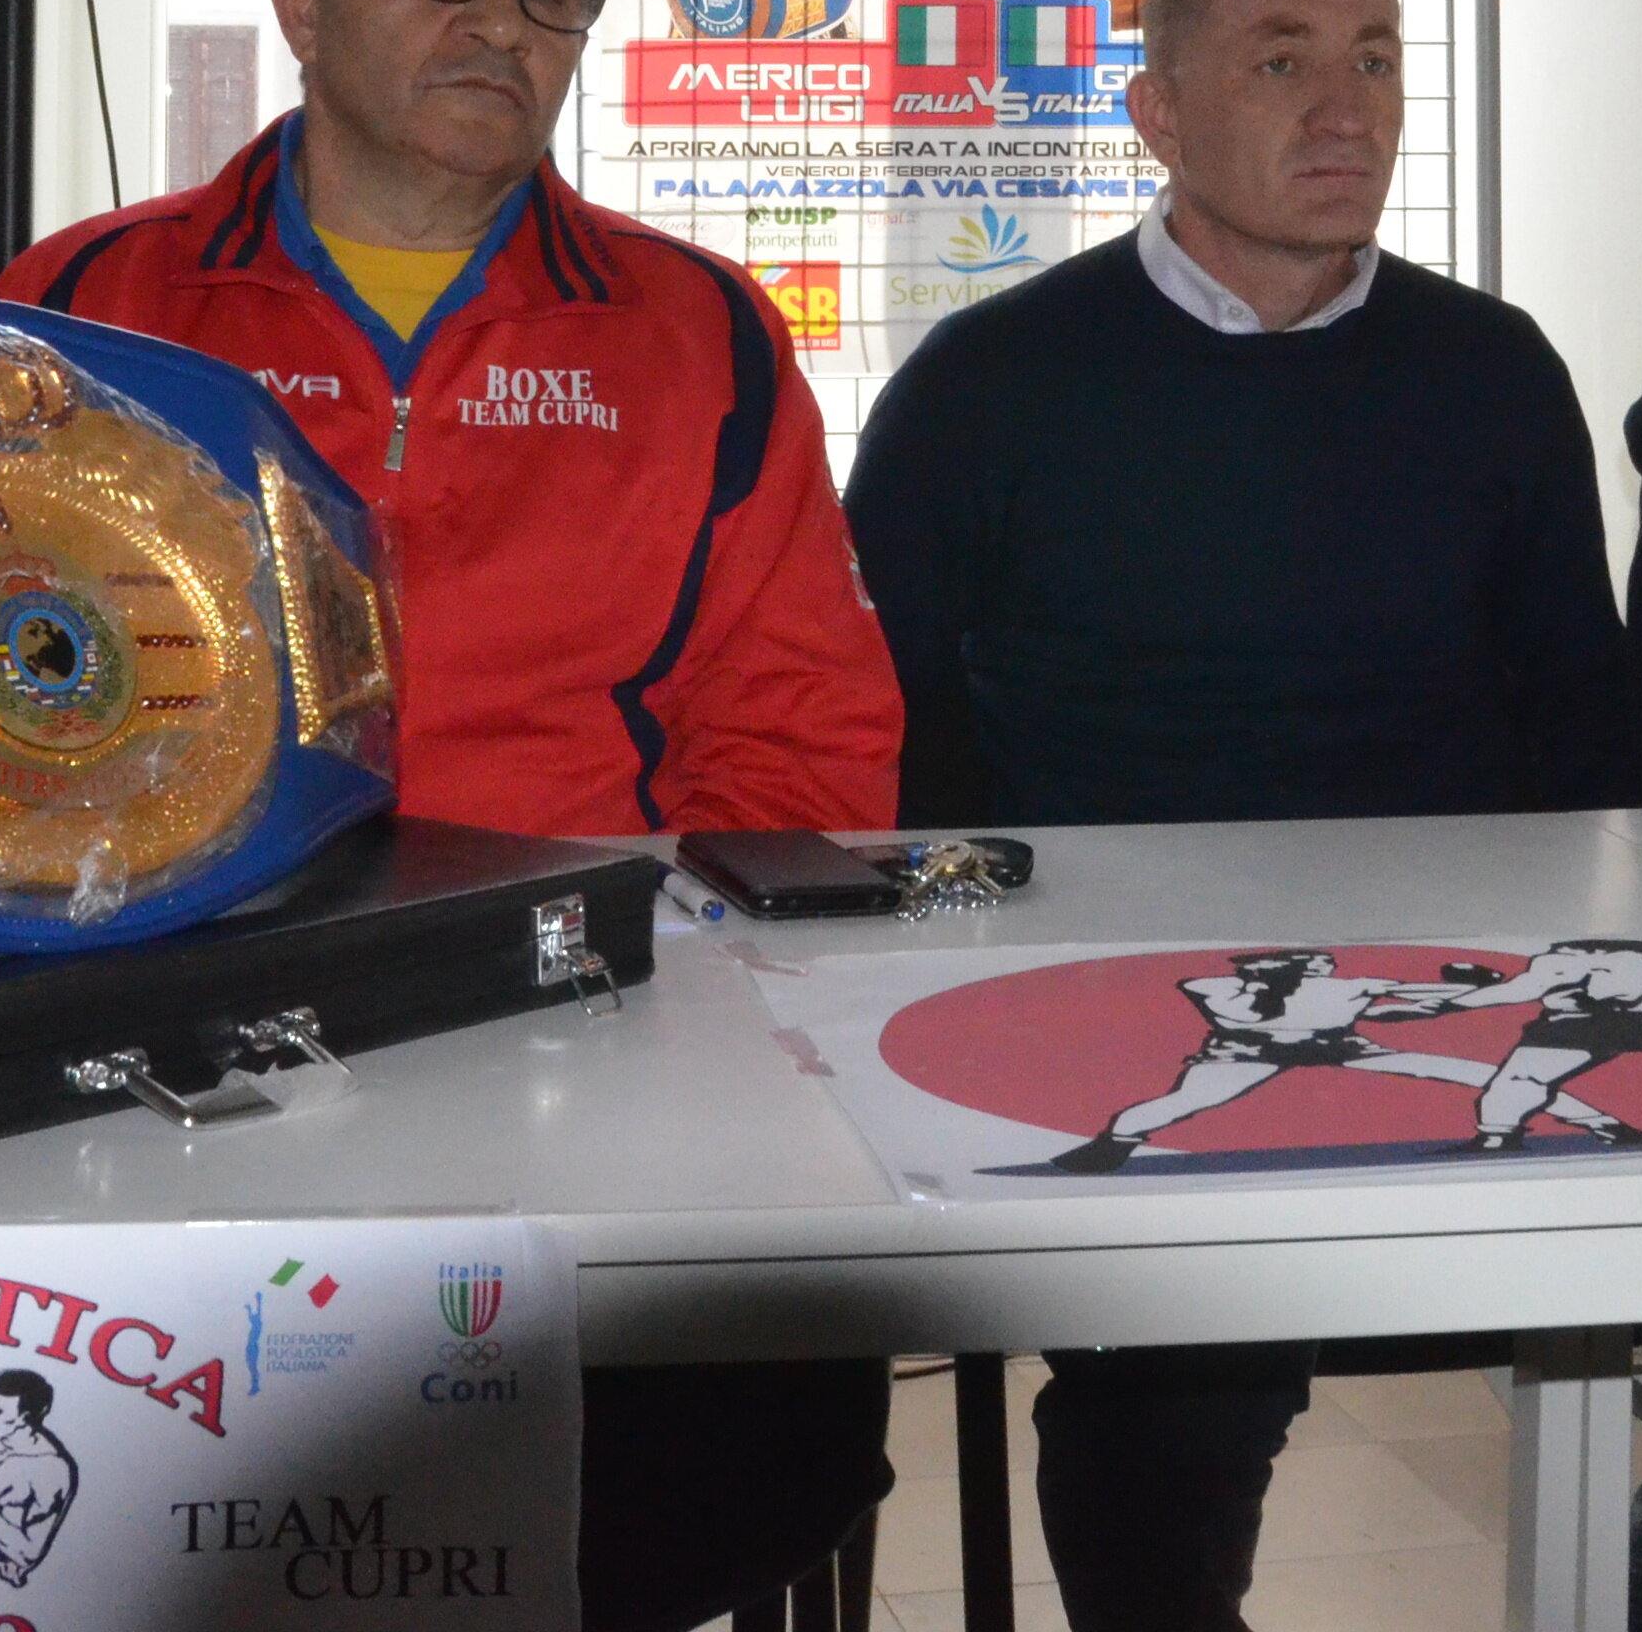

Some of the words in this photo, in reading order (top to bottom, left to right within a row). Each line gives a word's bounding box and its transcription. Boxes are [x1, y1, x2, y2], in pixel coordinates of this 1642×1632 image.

[668, 63, 870, 91] MERICO
[1094, 64, 1146, 91] G
[740, 95, 864, 123] LUIGI
[893, 93, 974, 114] ITALIA
[967, 76, 1032, 124] VS
[1032, 94, 1113, 114] ITALIA
[627, 141, 800, 157] APRIRANNO
[806, 141, 846, 157] LA
[856, 141, 978, 157] SERATA
[988, 141, 1116, 157] INCONTRI
[766, 165, 855, 177] VENERDI
[859, 165, 881, 177] 21
[883, 165, 987, 177] FEBBRAIO
[991, 165, 1047, 177] 2020
[1049, 165, 1122, 177] START
[1126, 165, 1166, 177] ORE
[654, 179, 926, 198] PALAMAZZOLA
[933, 179, 992, 198] VIA
[995, 179, 1128, 197] CESARE
[774, 206, 837, 225] UISP
[745, 232, 838, 248] sportpertutti
[766, 286, 838, 337] SB
[485, 364, 594, 403] BOXE
[458, 398, 530, 426] TEAM
[538, 401, 618, 431] CUPRI
[439, 1262, 503, 1279] Italia
[266, 1333, 355, 1345] FEDERAZIONE
[266, 1346, 347, 1359] PUGILISTICA
[266, 1360, 327, 1372] ITALIANA
[420, 1370, 518, 1403] Coni
[171, 1494, 392, 1553] TEAM
[284, 1545, 512, 1601] CUPRI
